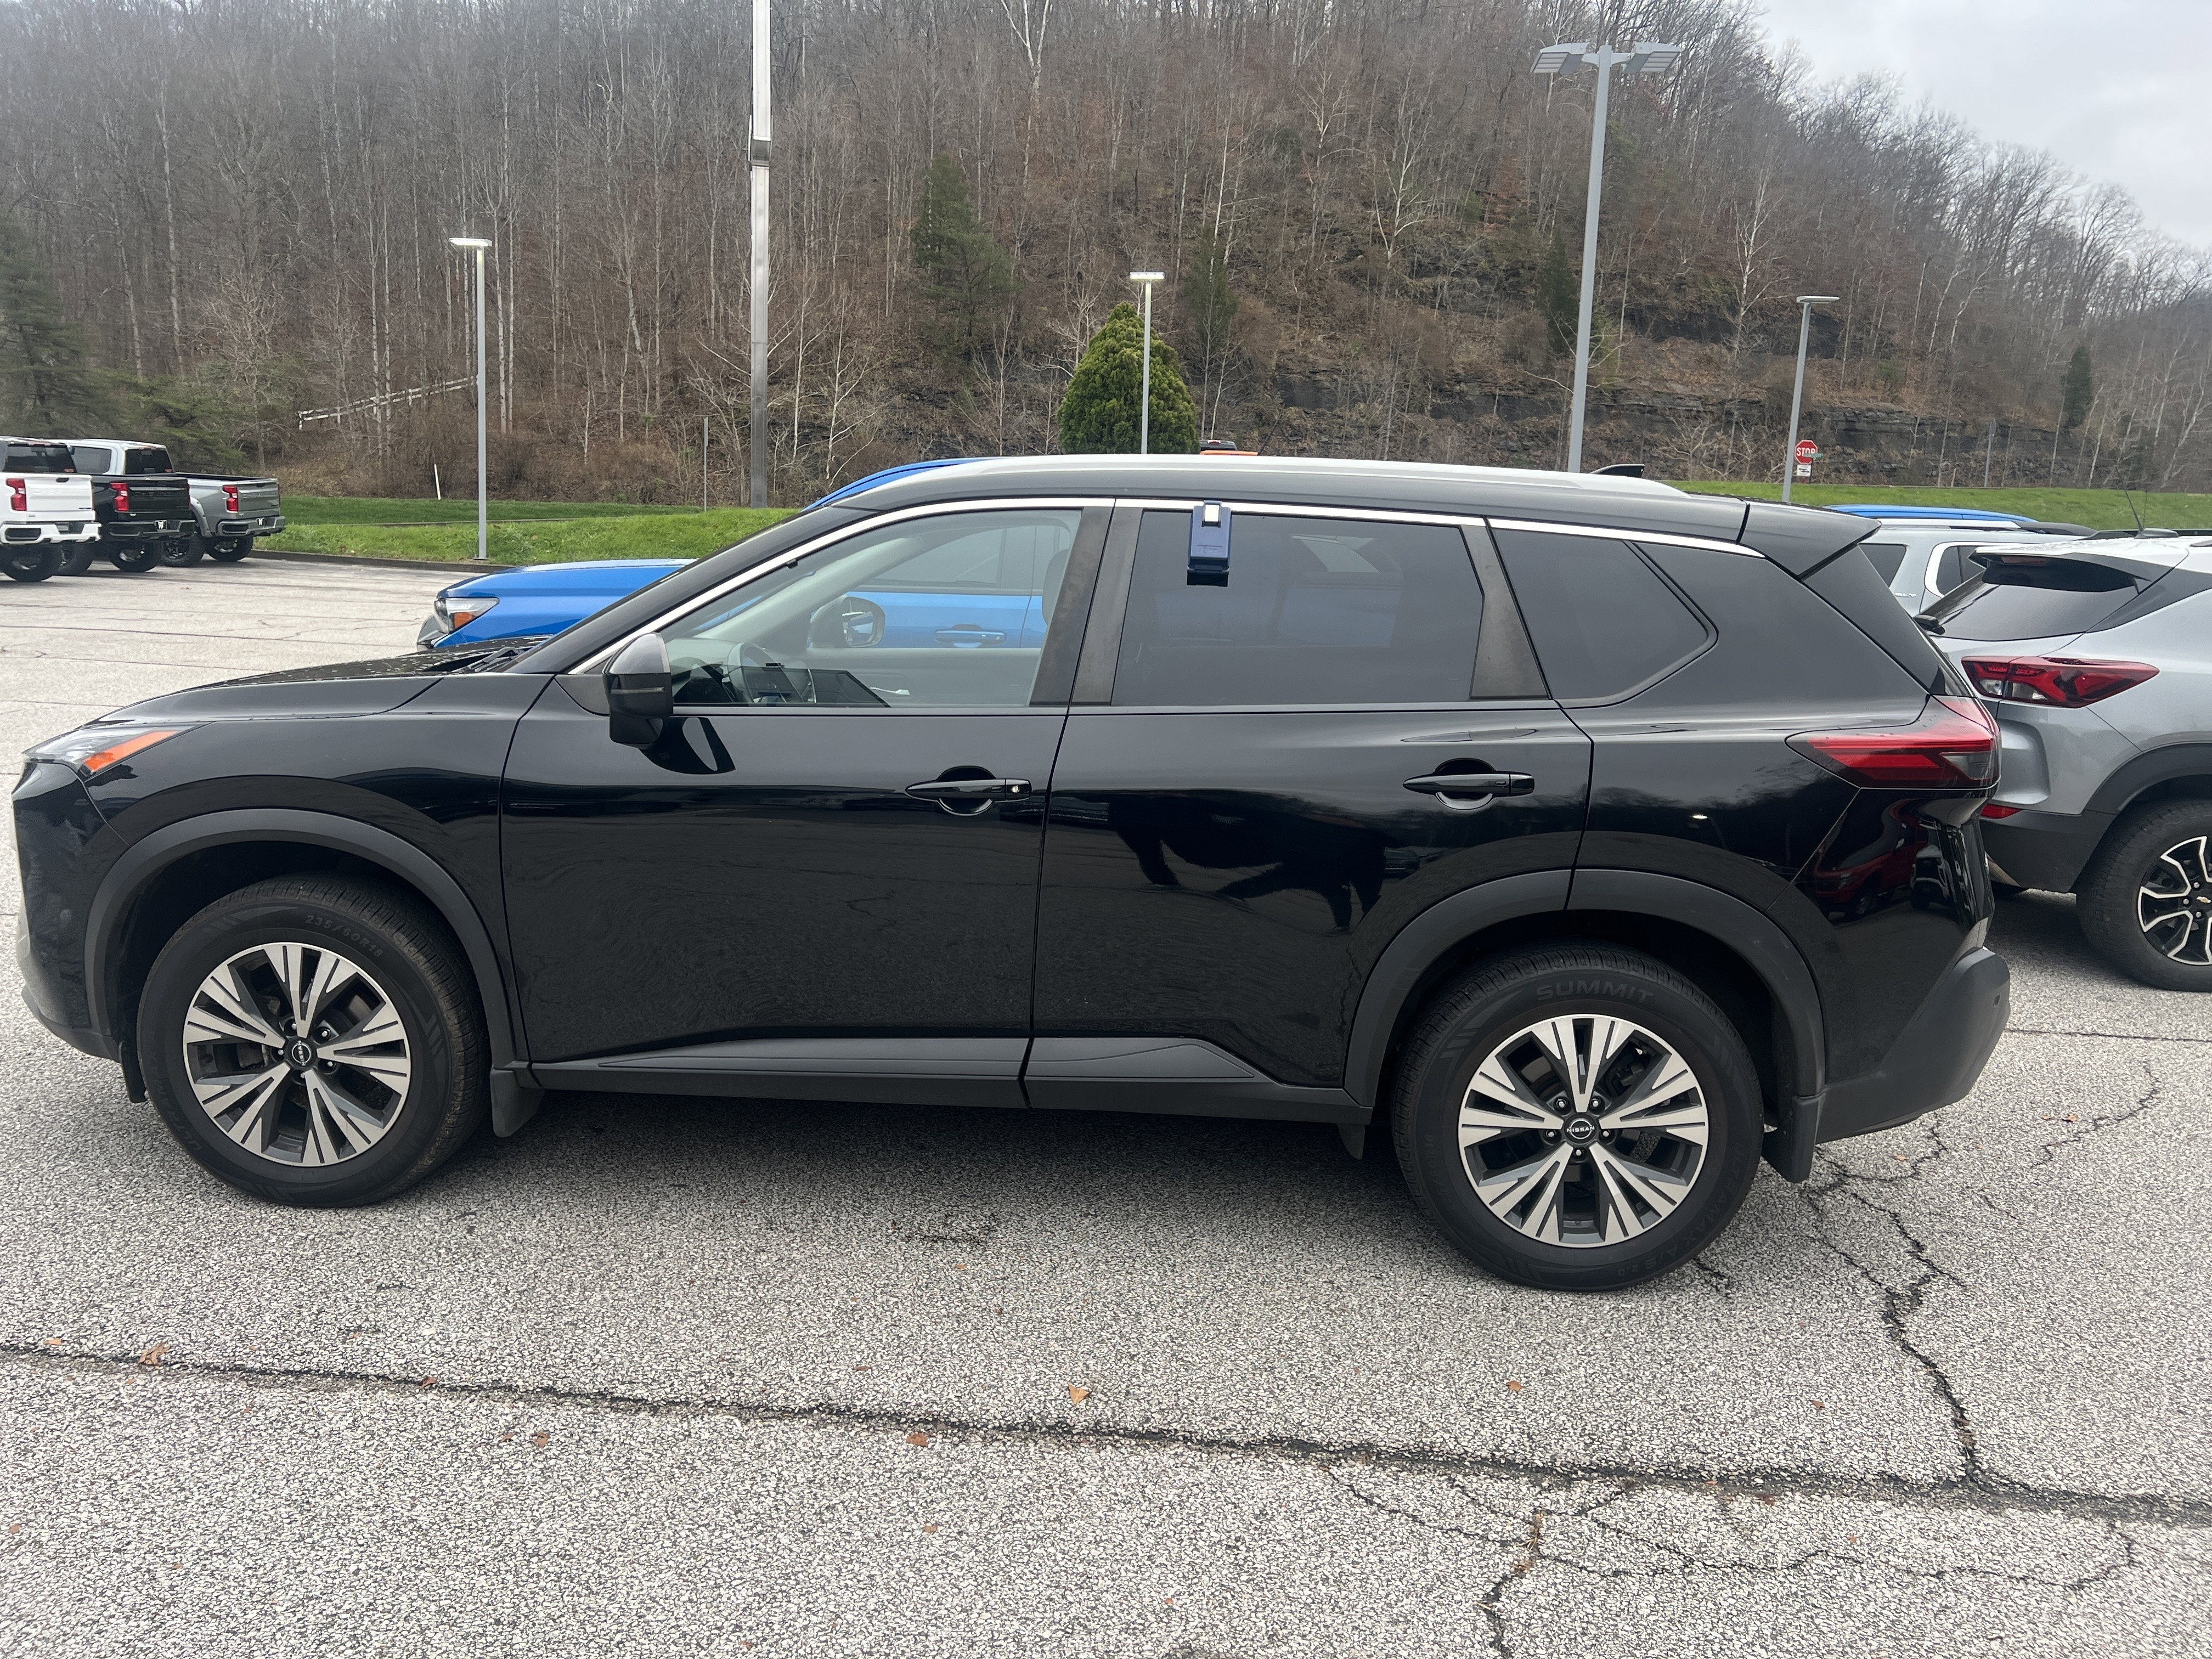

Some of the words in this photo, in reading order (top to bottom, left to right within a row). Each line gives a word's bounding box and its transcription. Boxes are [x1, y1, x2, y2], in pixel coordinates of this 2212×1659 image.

[1796, 447, 1816, 456] STOP
[305, 915, 383, 957] 235/60R18
[1537, 980, 1654, 1004] SUMMIT
